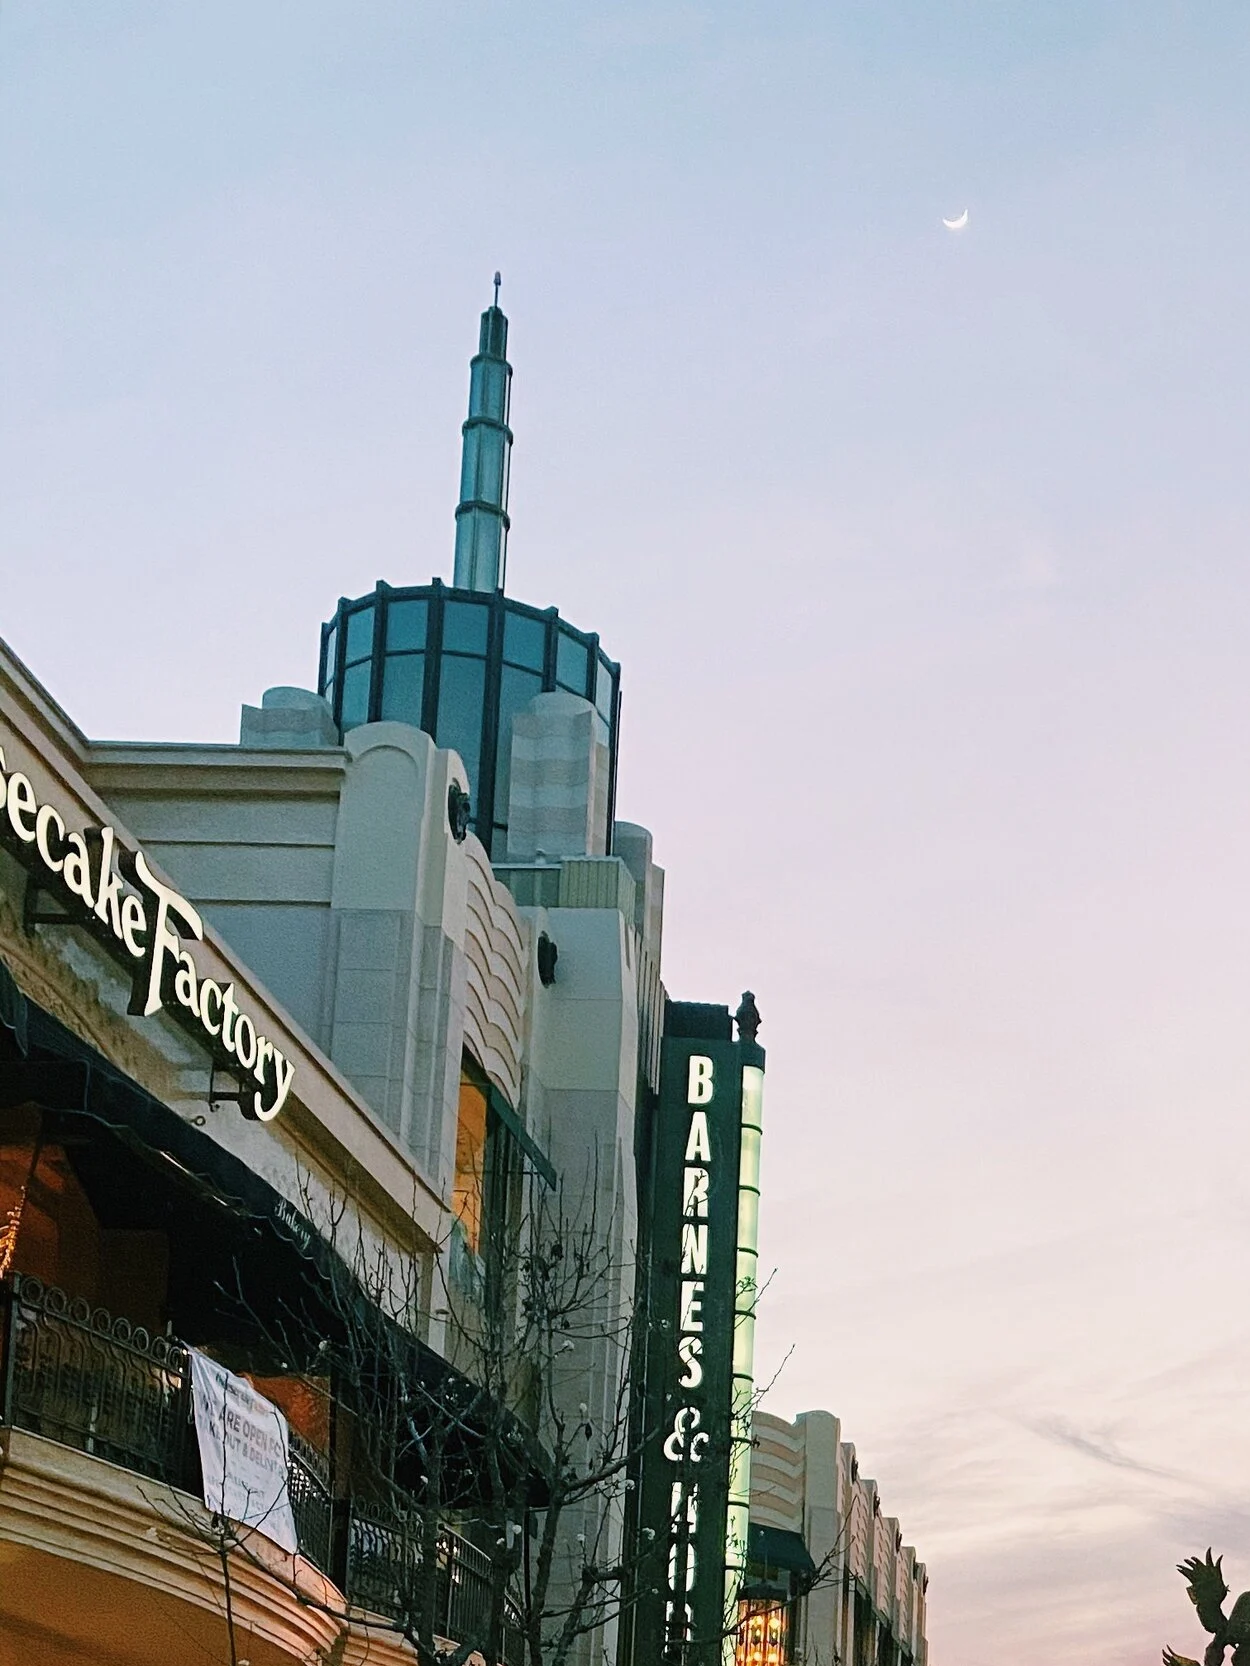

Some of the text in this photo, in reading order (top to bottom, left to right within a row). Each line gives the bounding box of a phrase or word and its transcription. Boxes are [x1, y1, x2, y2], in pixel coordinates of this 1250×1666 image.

[0, 745, 296, 1122] ecake Factory
[678, 1055, 714, 1388] BARNES
[218, 1406, 240, 1433] ARE
[242, 1420, 267, 1449] OPEN
[663, 1406, 709, 1463] &
